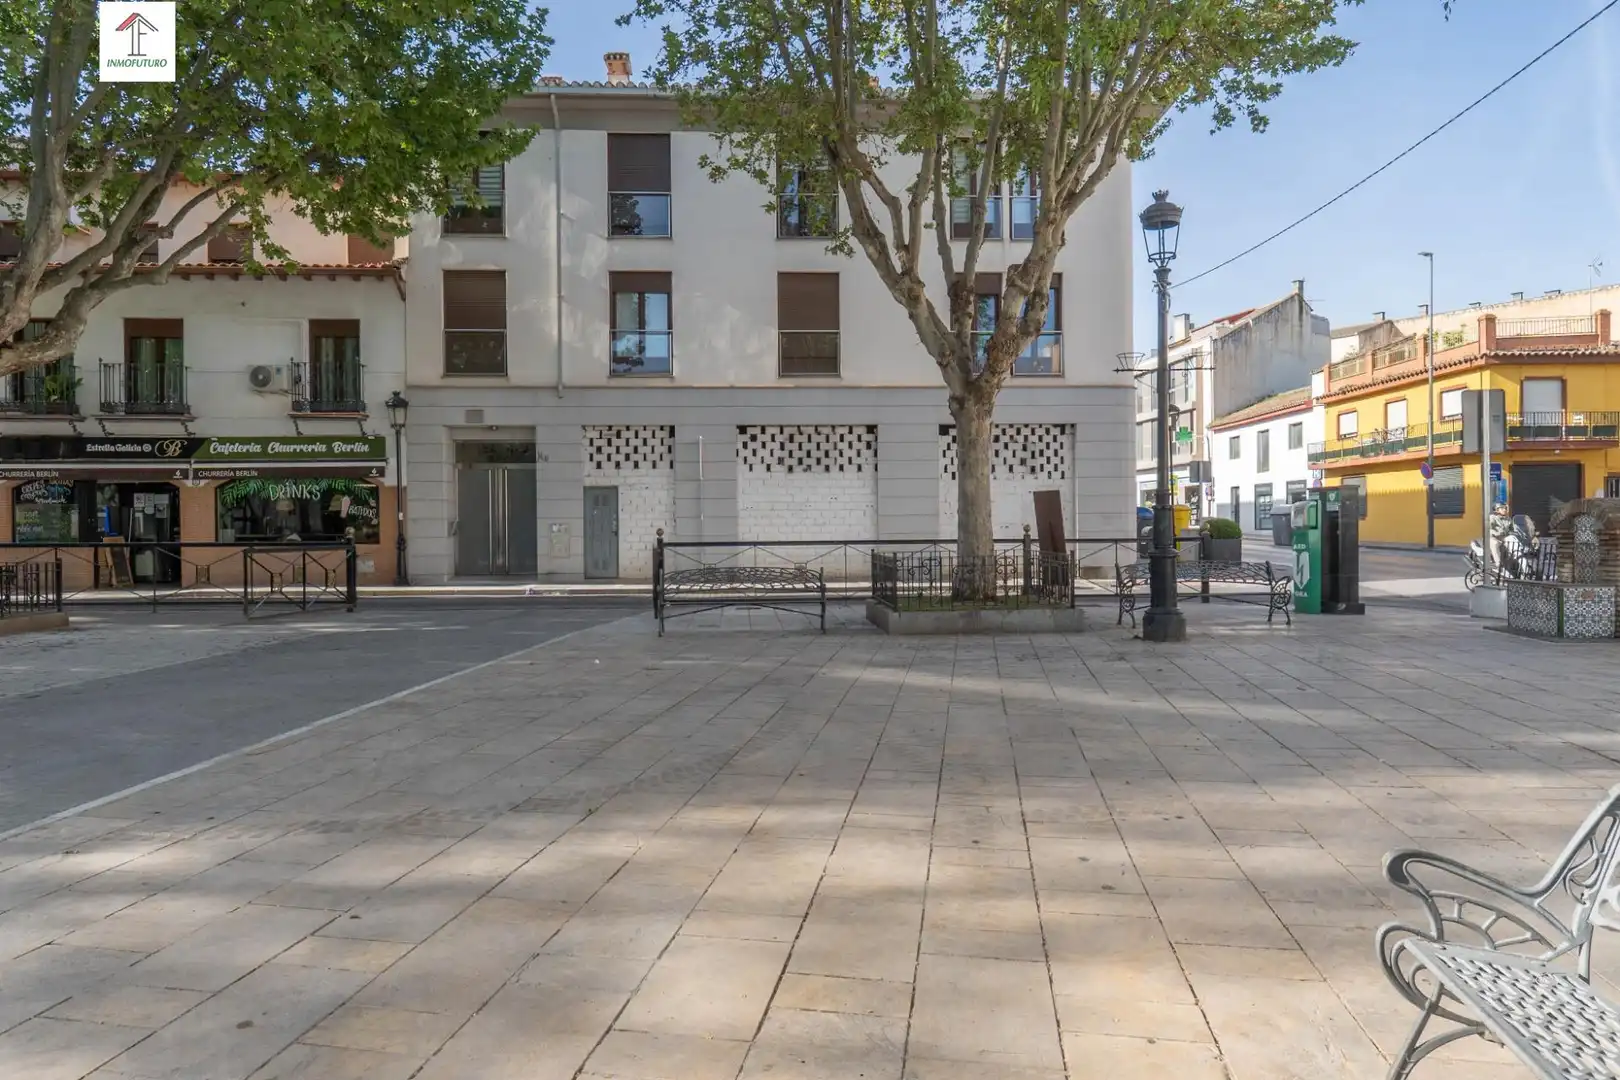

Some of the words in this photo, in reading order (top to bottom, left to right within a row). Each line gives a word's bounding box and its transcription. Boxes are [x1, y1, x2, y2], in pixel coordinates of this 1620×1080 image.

[85, 443, 115, 452] Estrella
[115, 443, 142, 452] Galicia
[269, 483, 321, 501] DRINKS
